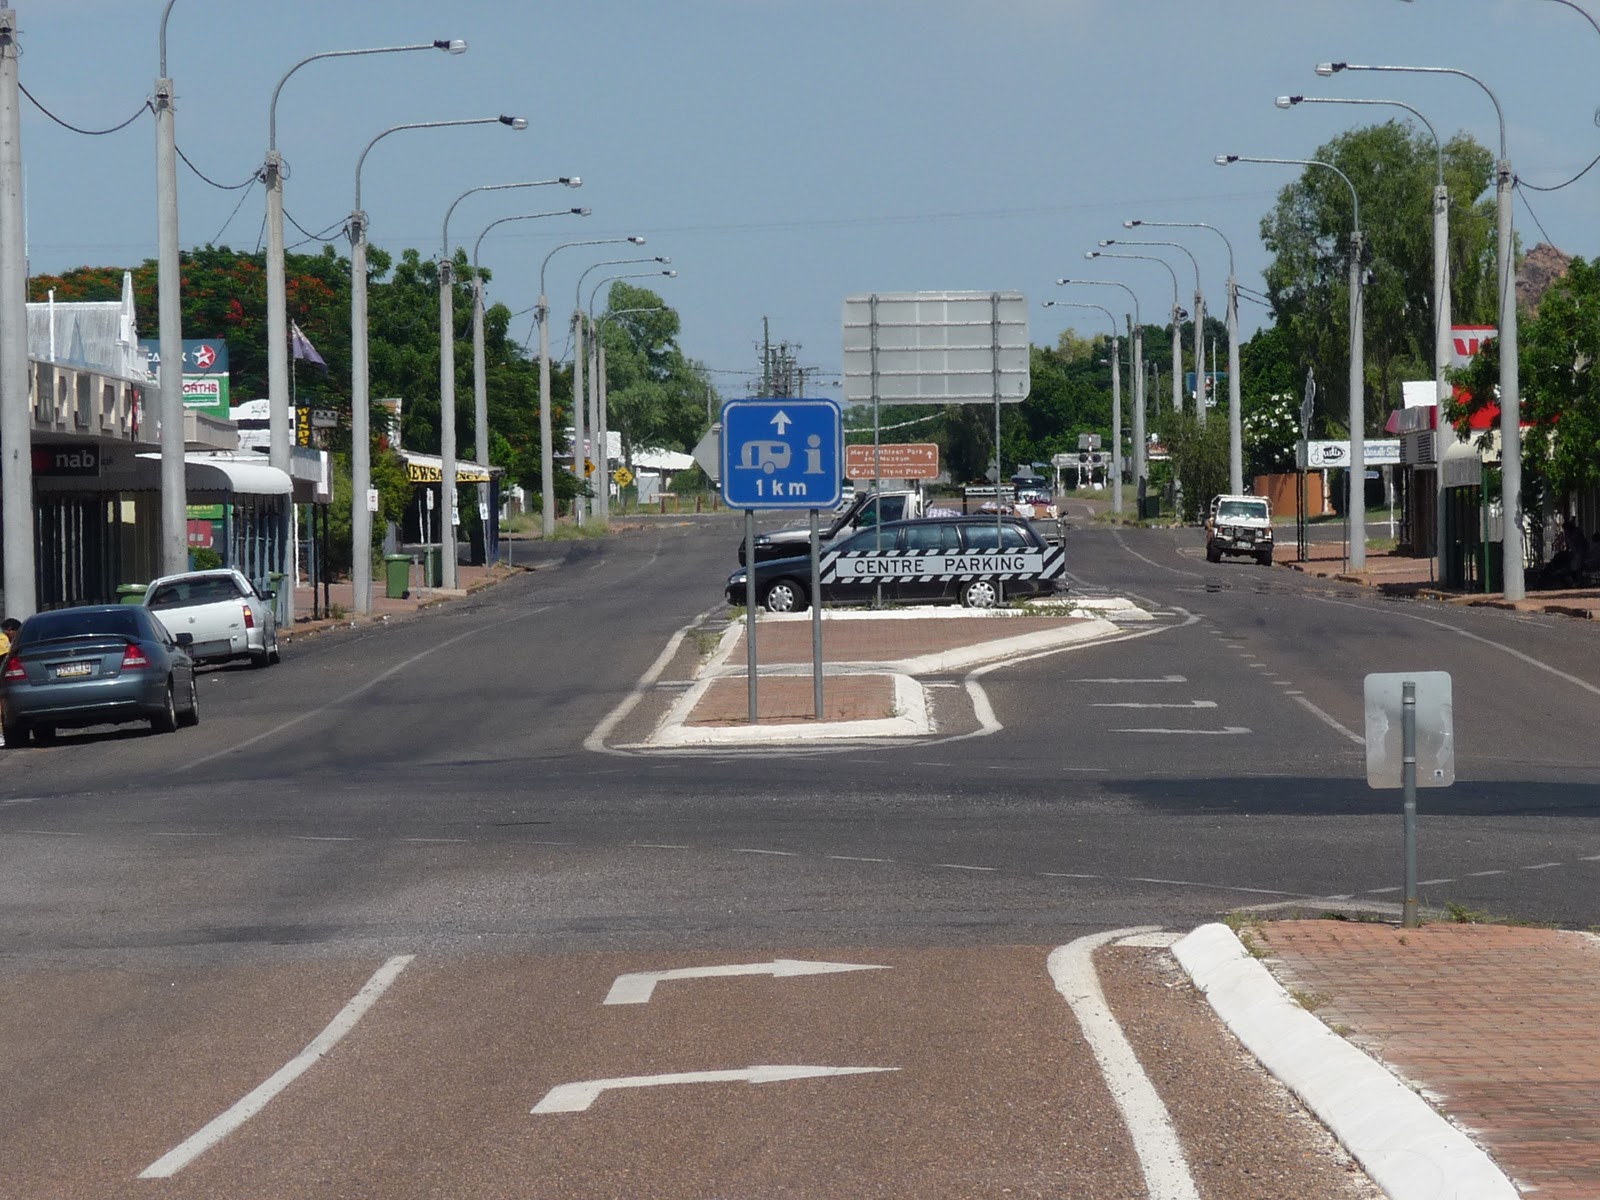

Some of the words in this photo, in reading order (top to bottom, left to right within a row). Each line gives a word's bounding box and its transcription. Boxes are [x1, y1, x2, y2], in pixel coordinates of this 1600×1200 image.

[56, 449, 95, 468] nab
[755, 479, 763, 496] 1
[772, 478, 807, 496] km
[854, 559, 925, 574] CENTRE
[944, 557, 1025, 572] PARKING
